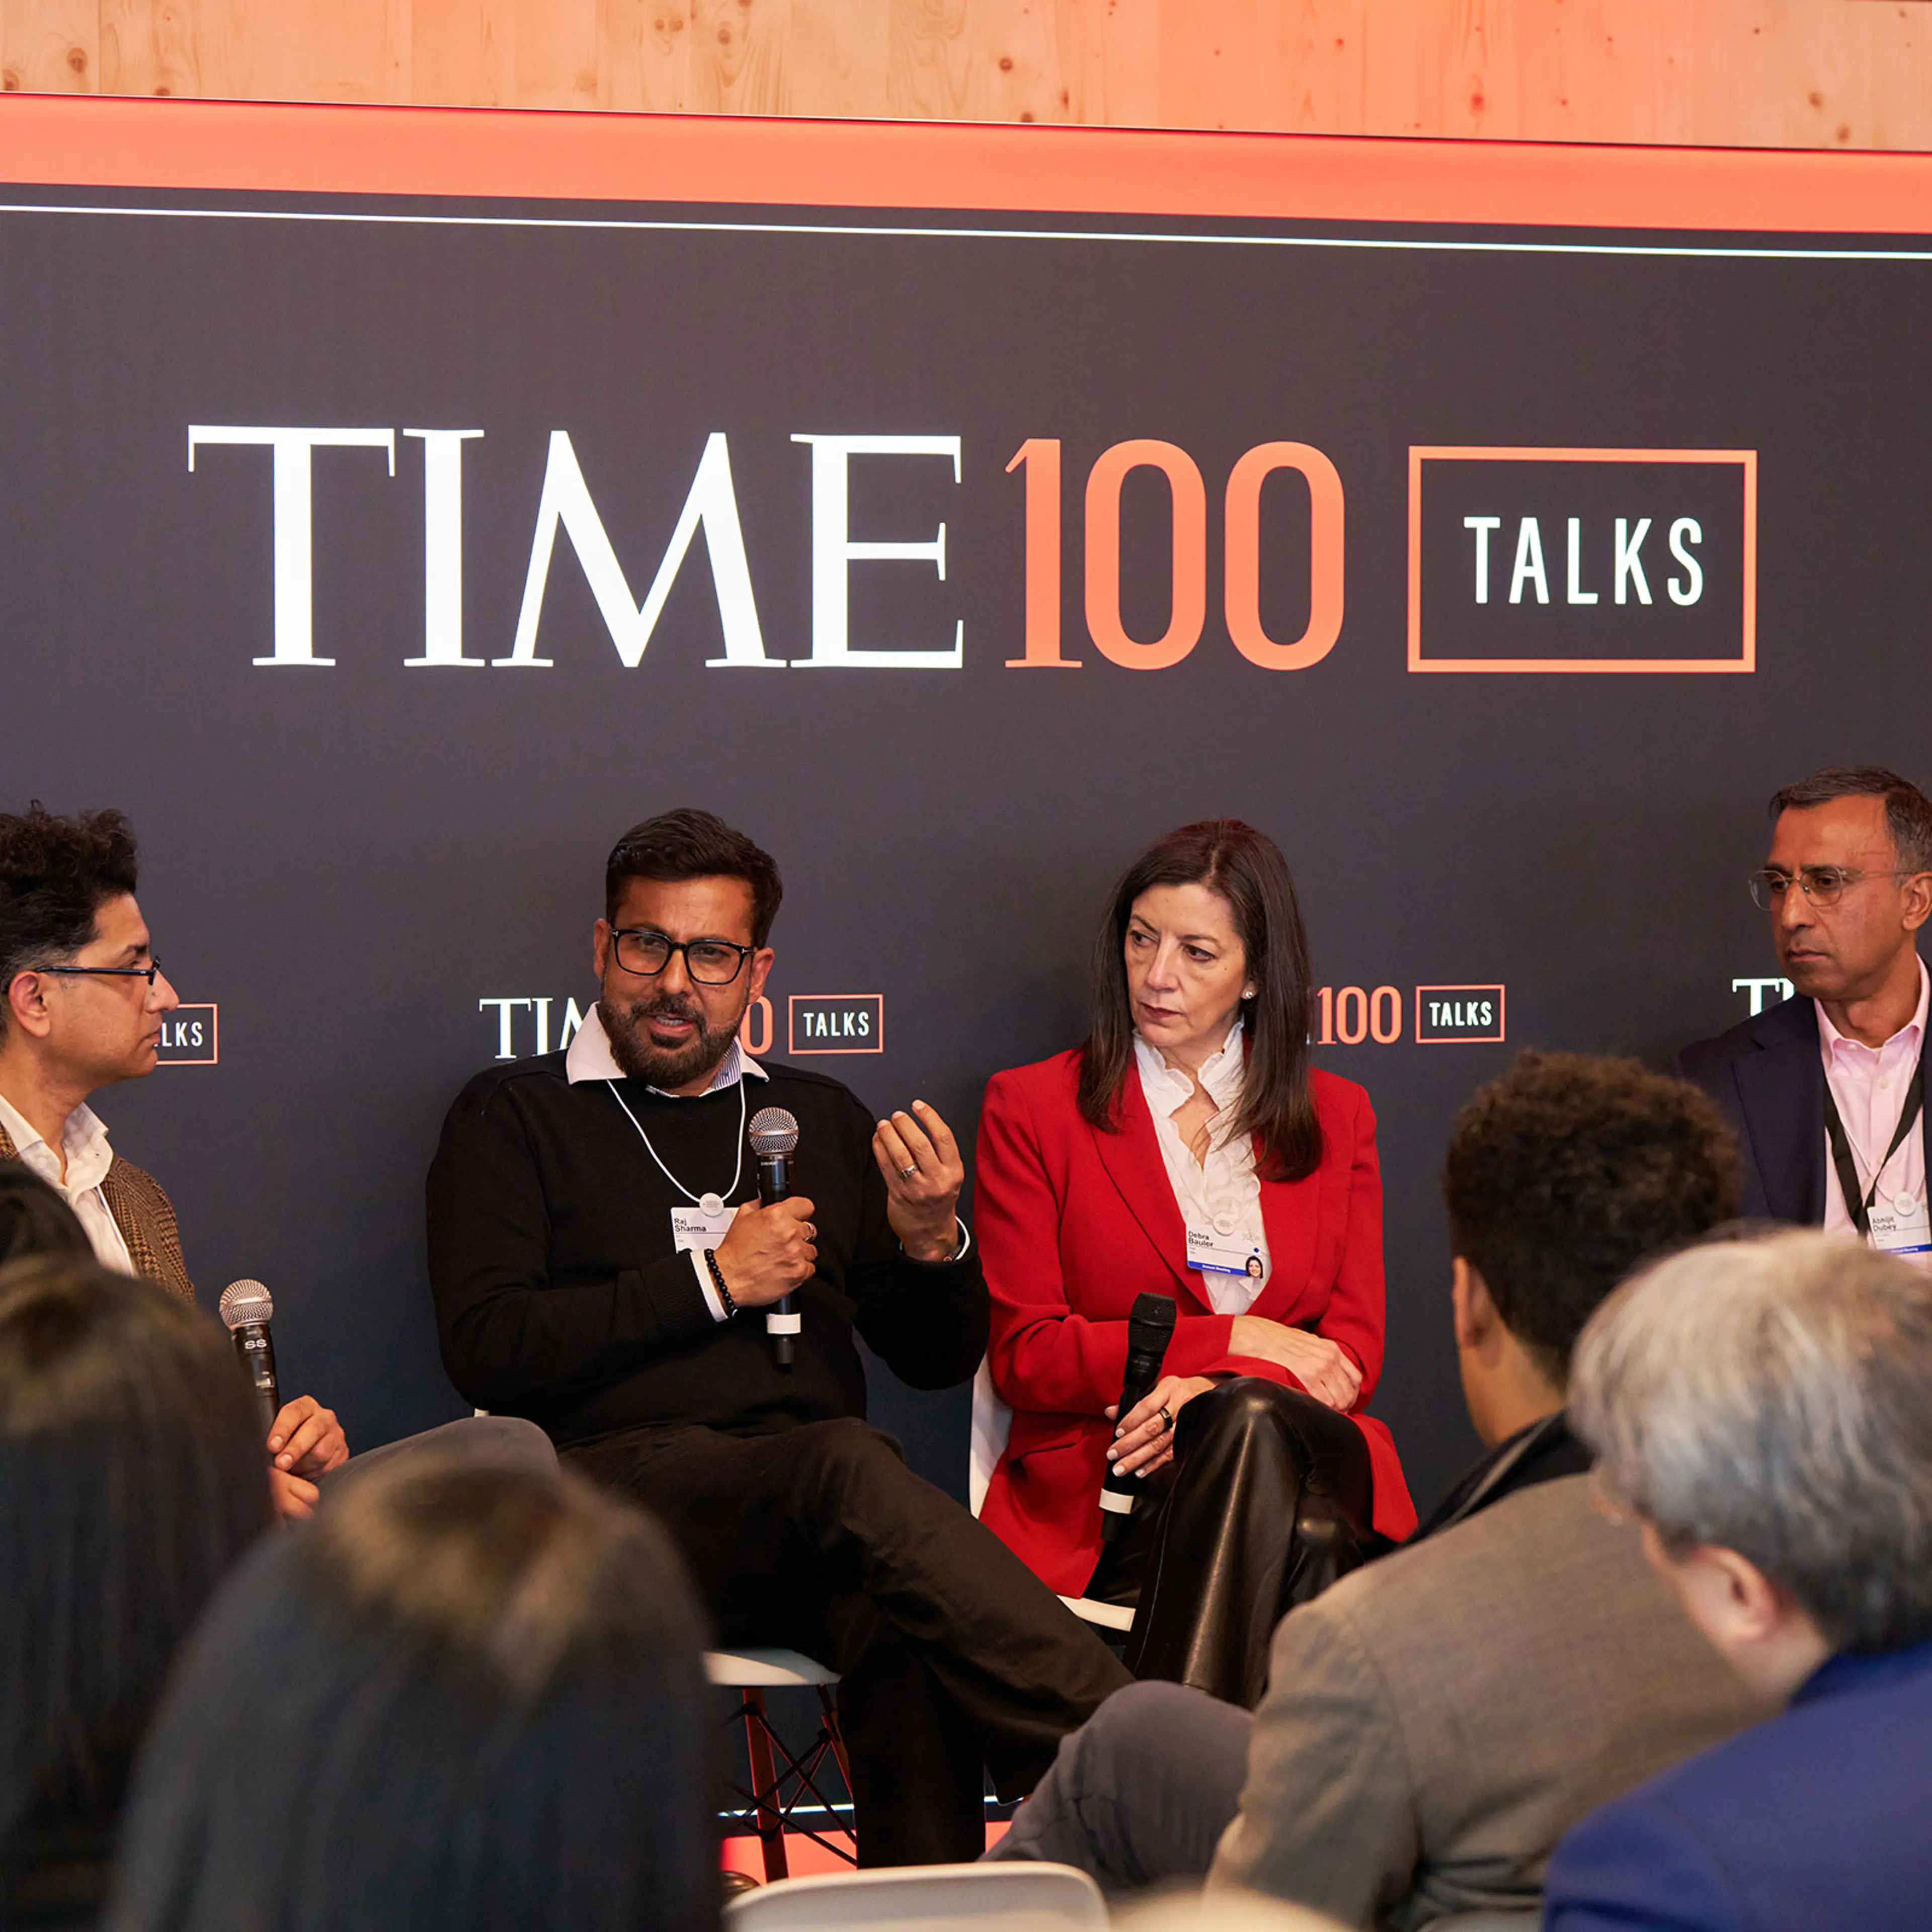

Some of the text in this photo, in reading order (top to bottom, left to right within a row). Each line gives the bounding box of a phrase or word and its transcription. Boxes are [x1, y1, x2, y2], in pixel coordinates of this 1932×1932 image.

[188, 425, 1703, 671] TIME 100 TALKS
[802, 1011, 869, 1036] TALKS
[1317, 986, 1492, 1044] 100 TALKS
[675, 1224, 706, 1232] Sharma
[1188, 1230, 1209, 1240] Debra
